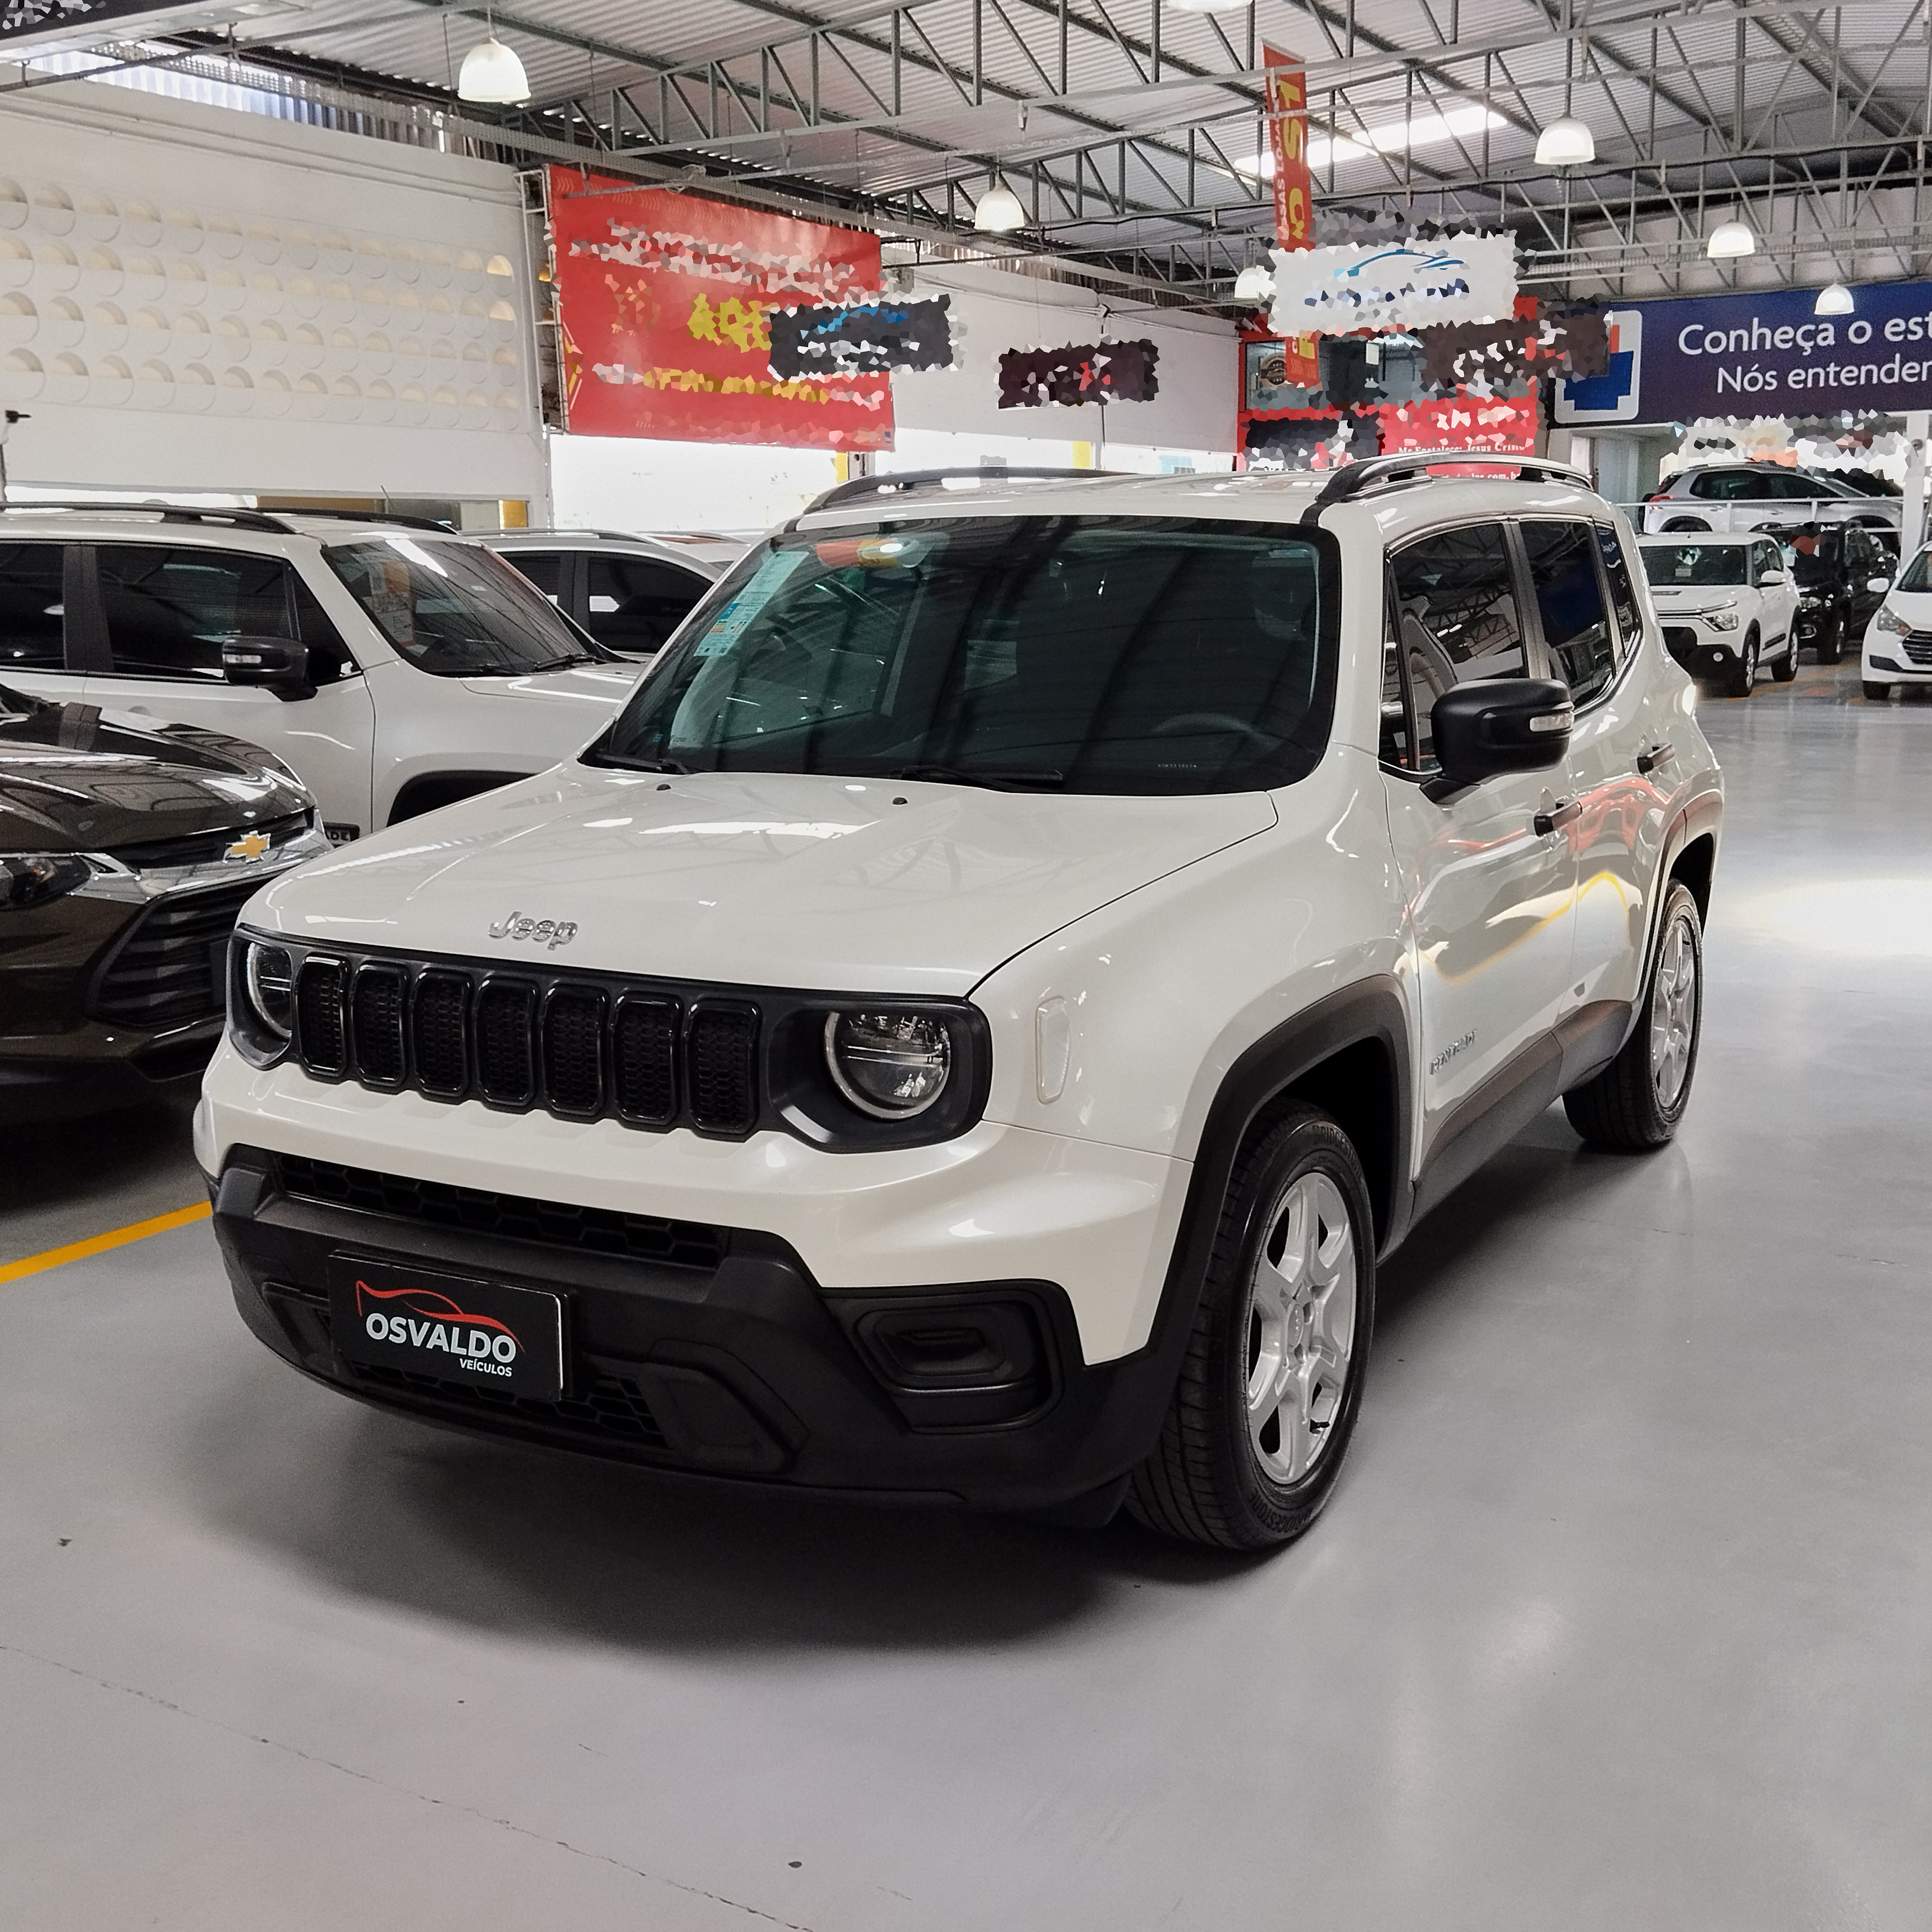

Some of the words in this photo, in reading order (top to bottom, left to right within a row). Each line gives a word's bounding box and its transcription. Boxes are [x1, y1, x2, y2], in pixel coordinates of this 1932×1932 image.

[1678, 317, 1834, 355] Conheça
[1848, 320, 1871, 343] o
[1717, 363, 1777, 392] Nós
[488, 911, 578, 951] Jeep
[365, 1313, 516, 1363] OSVALDO
[459, 1358, 513, 1377] VEÍCULOS
